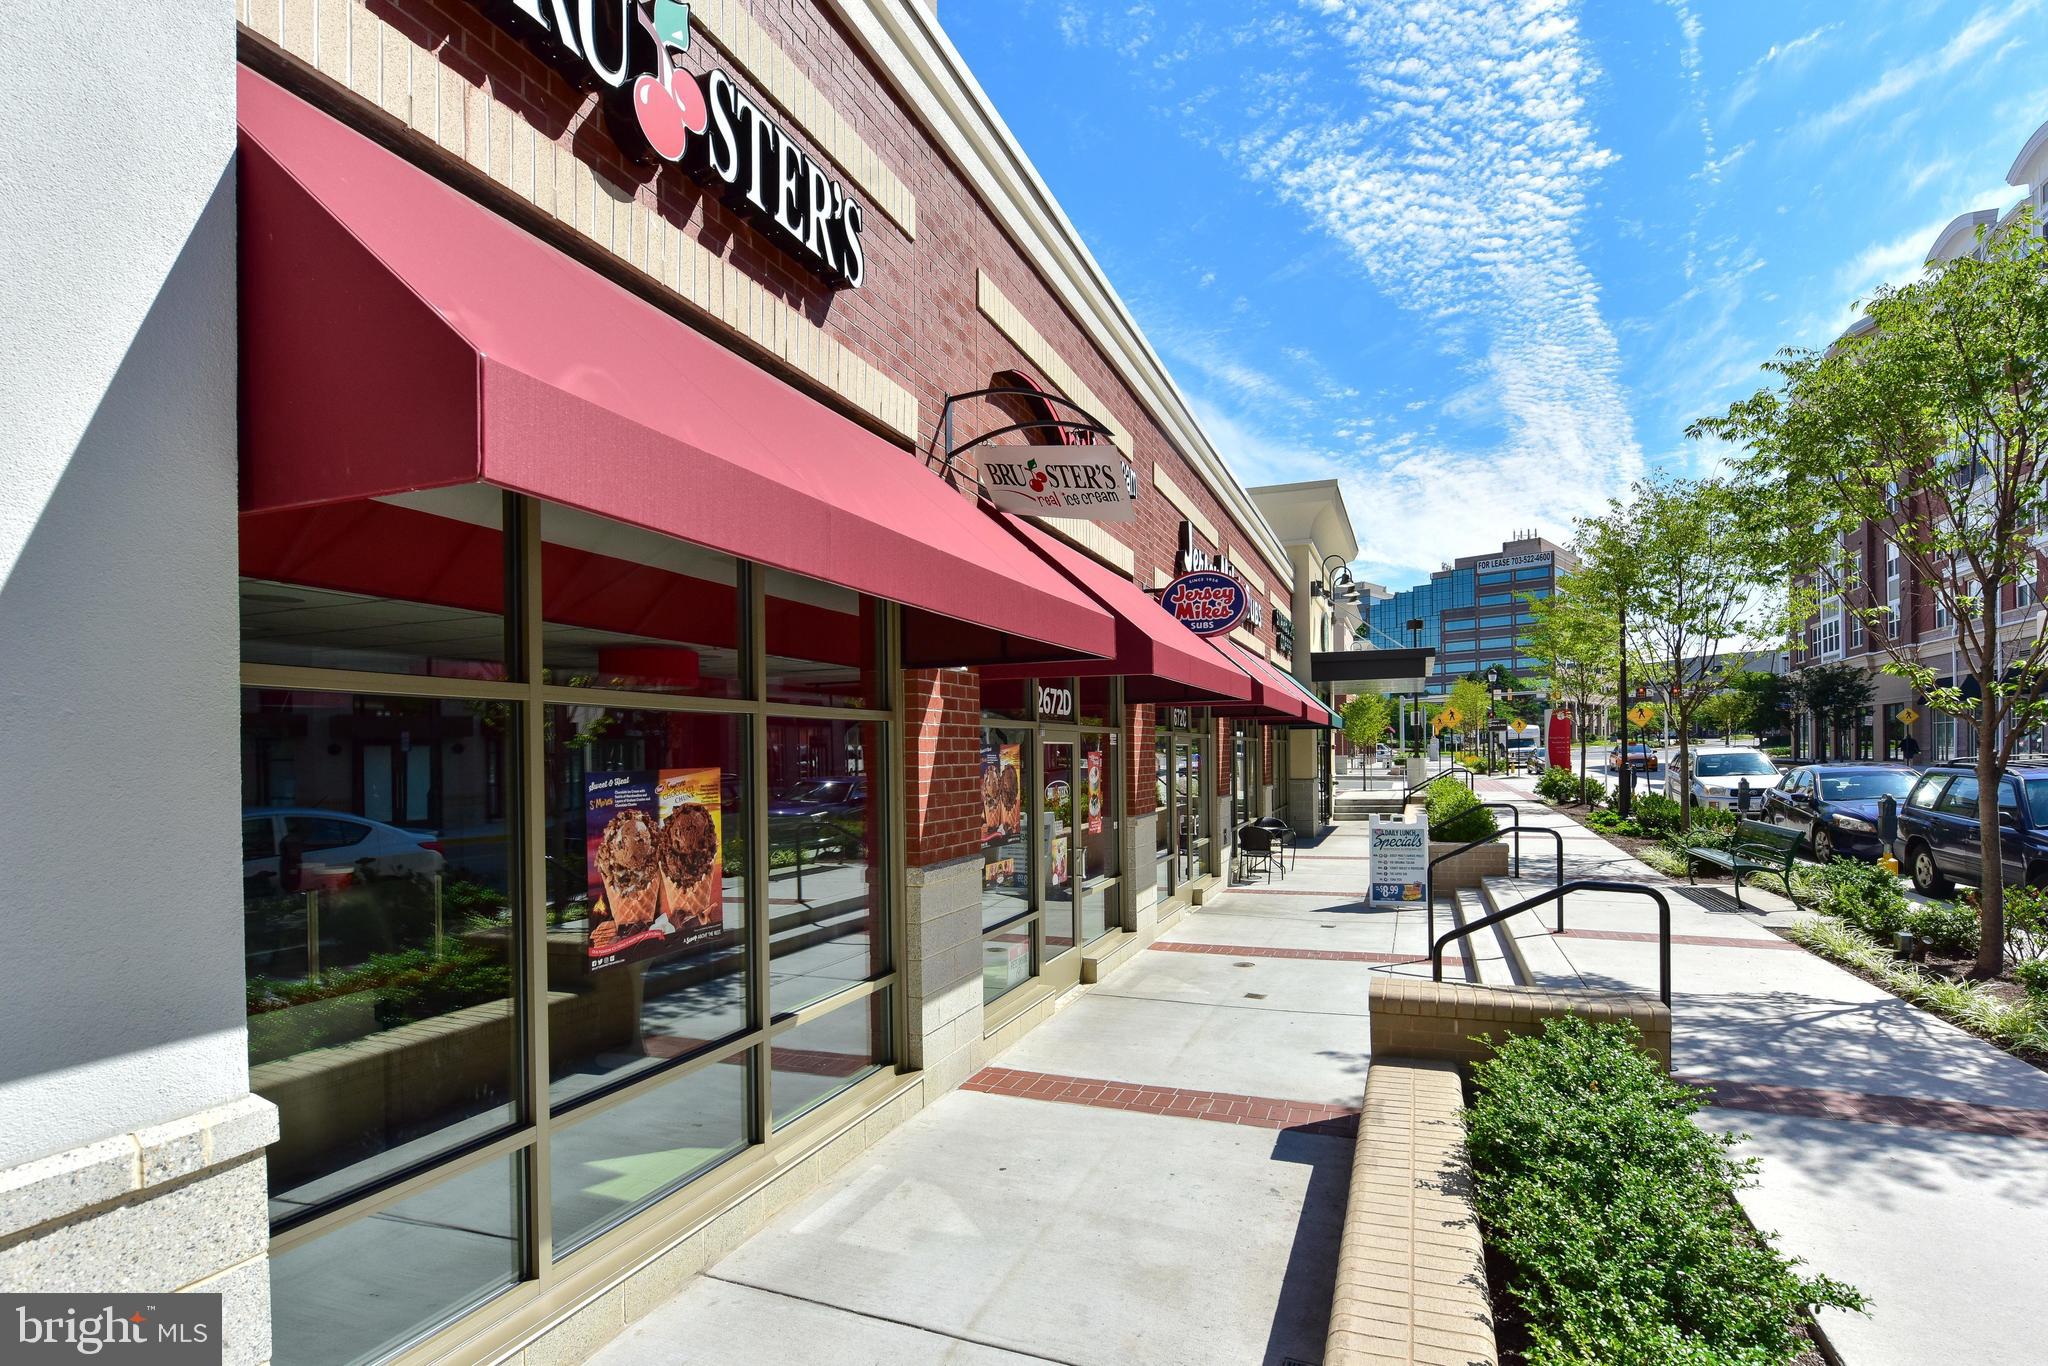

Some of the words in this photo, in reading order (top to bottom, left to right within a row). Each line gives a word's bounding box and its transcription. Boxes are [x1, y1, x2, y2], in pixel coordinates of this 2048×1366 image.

[1036, 491, 1061, 507] real
[1062, 492, 1080, 506] ice
[1080, 491, 1119, 505] cream
[1491, 558, 1510, 568] LEASE
[1511, 553, 1551, 565] 703-522-4600
[1171, 584, 1235, 604] Jersey
[1175, 601, 1233, 620] Mike's
[1191, 621, 1214, 629] SUBS
[1039, 686, 1072, 716] 2672D
[1373, 834, 1423, 850] Specials
